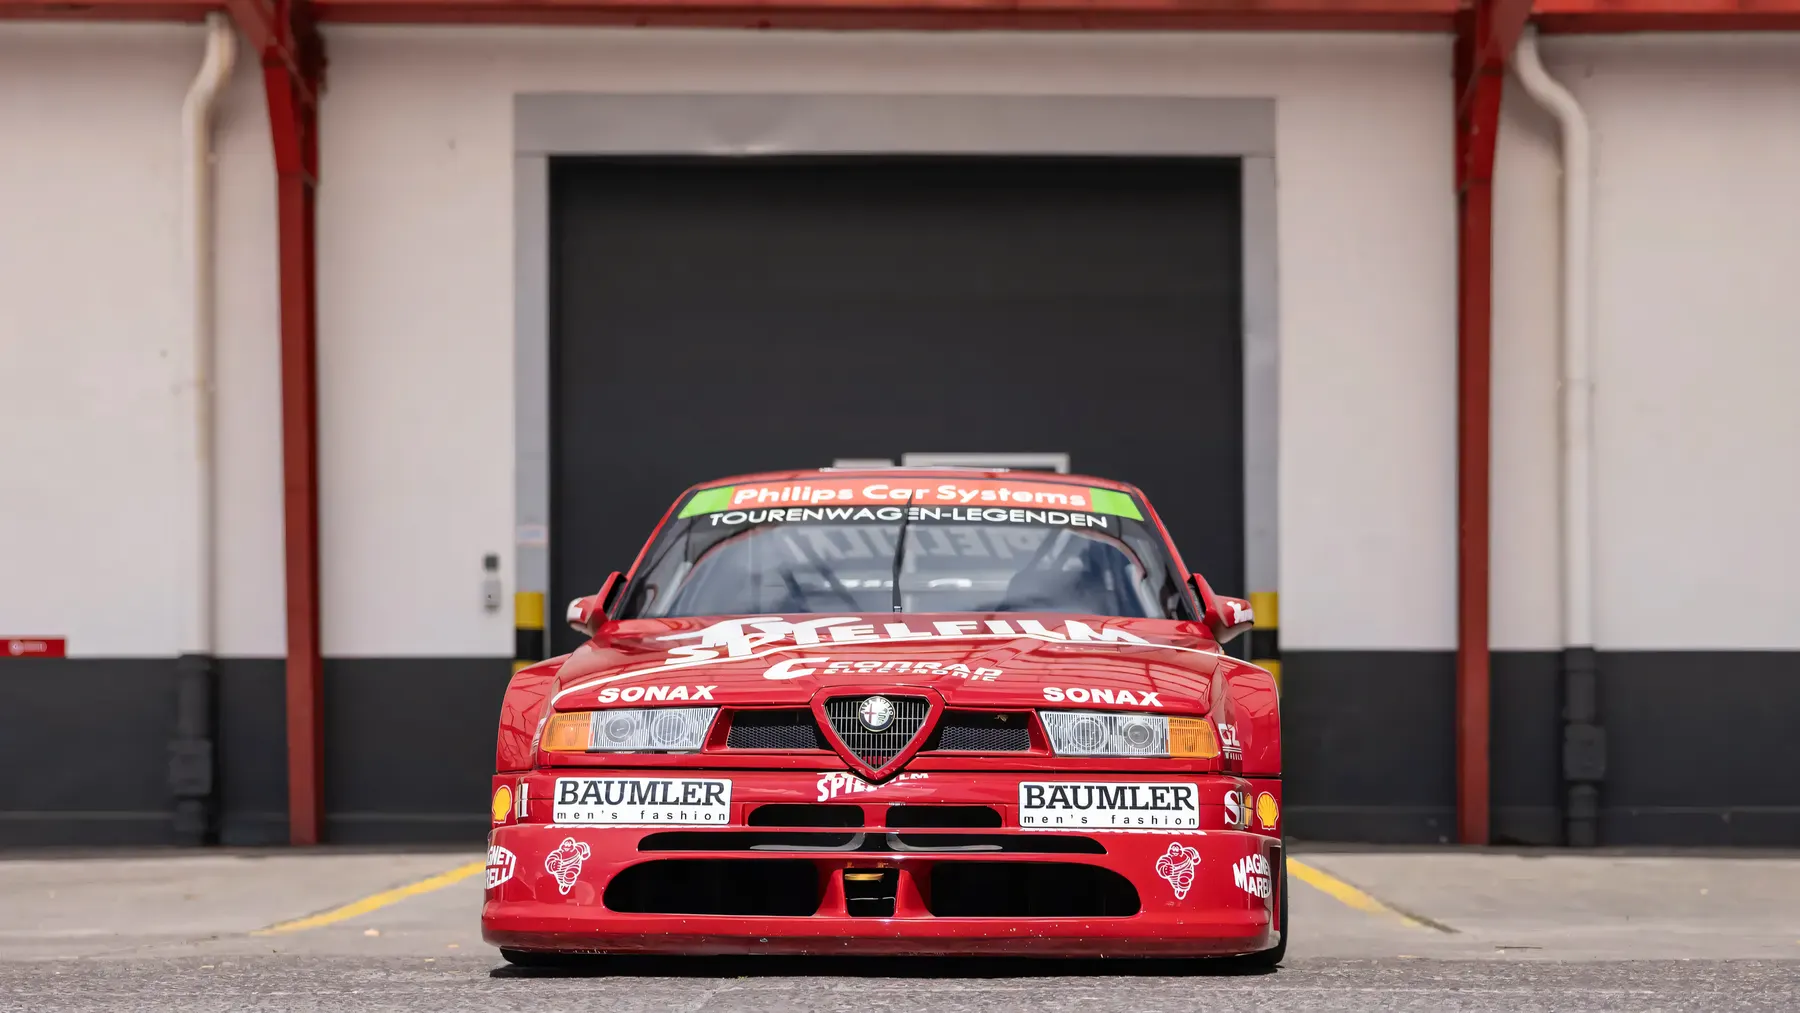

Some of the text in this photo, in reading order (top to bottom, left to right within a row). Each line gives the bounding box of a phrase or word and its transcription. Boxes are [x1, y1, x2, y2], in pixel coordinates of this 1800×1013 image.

[734, 484, 1087, 506] Philips Car Systems
[709, 506, 1109, 529] TOURENWAGEN-LEGENDEN
[598, 685, 719, 703] SONAX
[1043, 686, 1164, 707] SONAX
[557, 780, 726, 806] BÄUMLER
[1023, 784, 1195, 811] BÄUMLER
[556, 810, 726, 821] men's fashion
[1024, 814, 1196, 826] men's fashion
